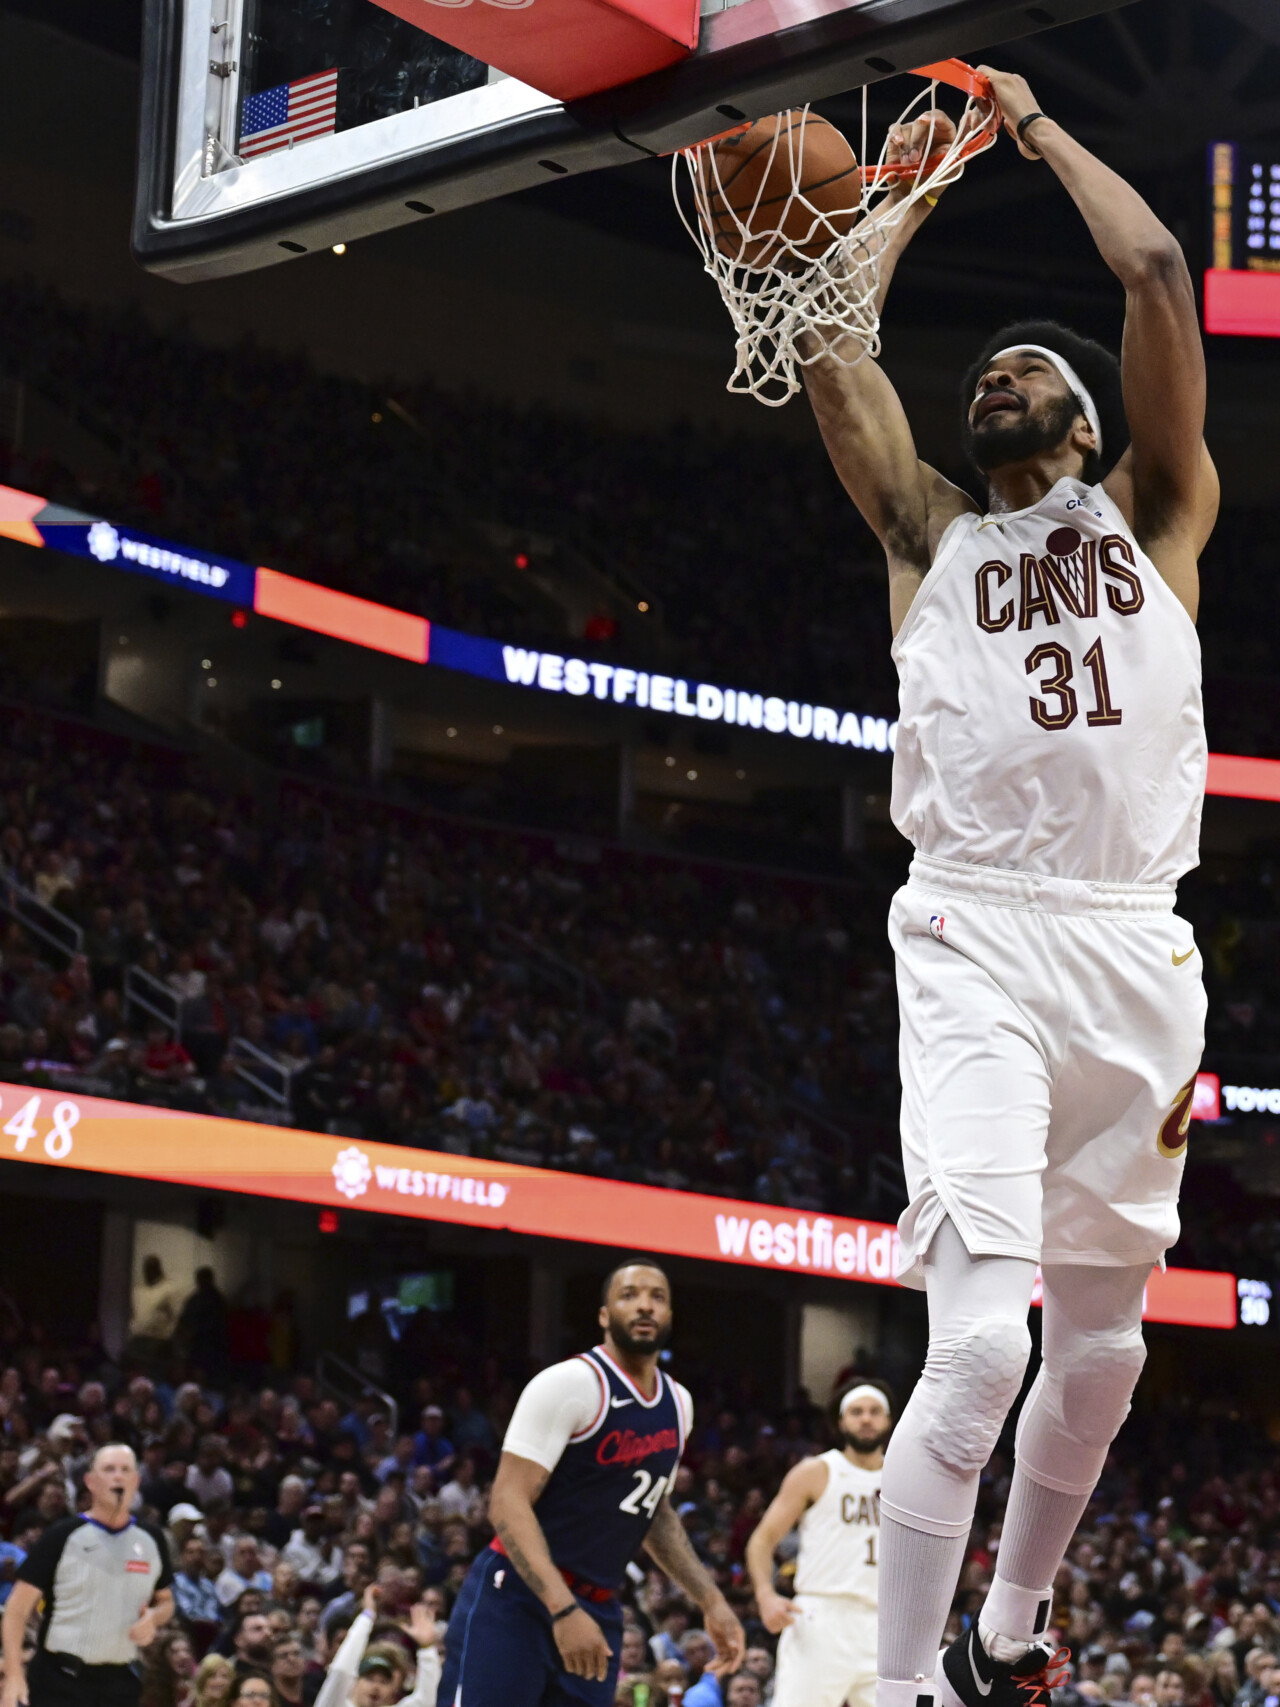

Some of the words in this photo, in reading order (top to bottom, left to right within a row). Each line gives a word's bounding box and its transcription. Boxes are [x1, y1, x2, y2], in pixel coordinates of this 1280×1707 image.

[119, 536, 230, 588] WESTFIELD
[975, 533, 1145, 634] CAVS
[1024, 635, 1122, 731] 31
[0, 1094, 81, 1160] 48
[375, 1162, 511, 1208] WESTFIELD
[619, 1469, 668, 1519] 24
